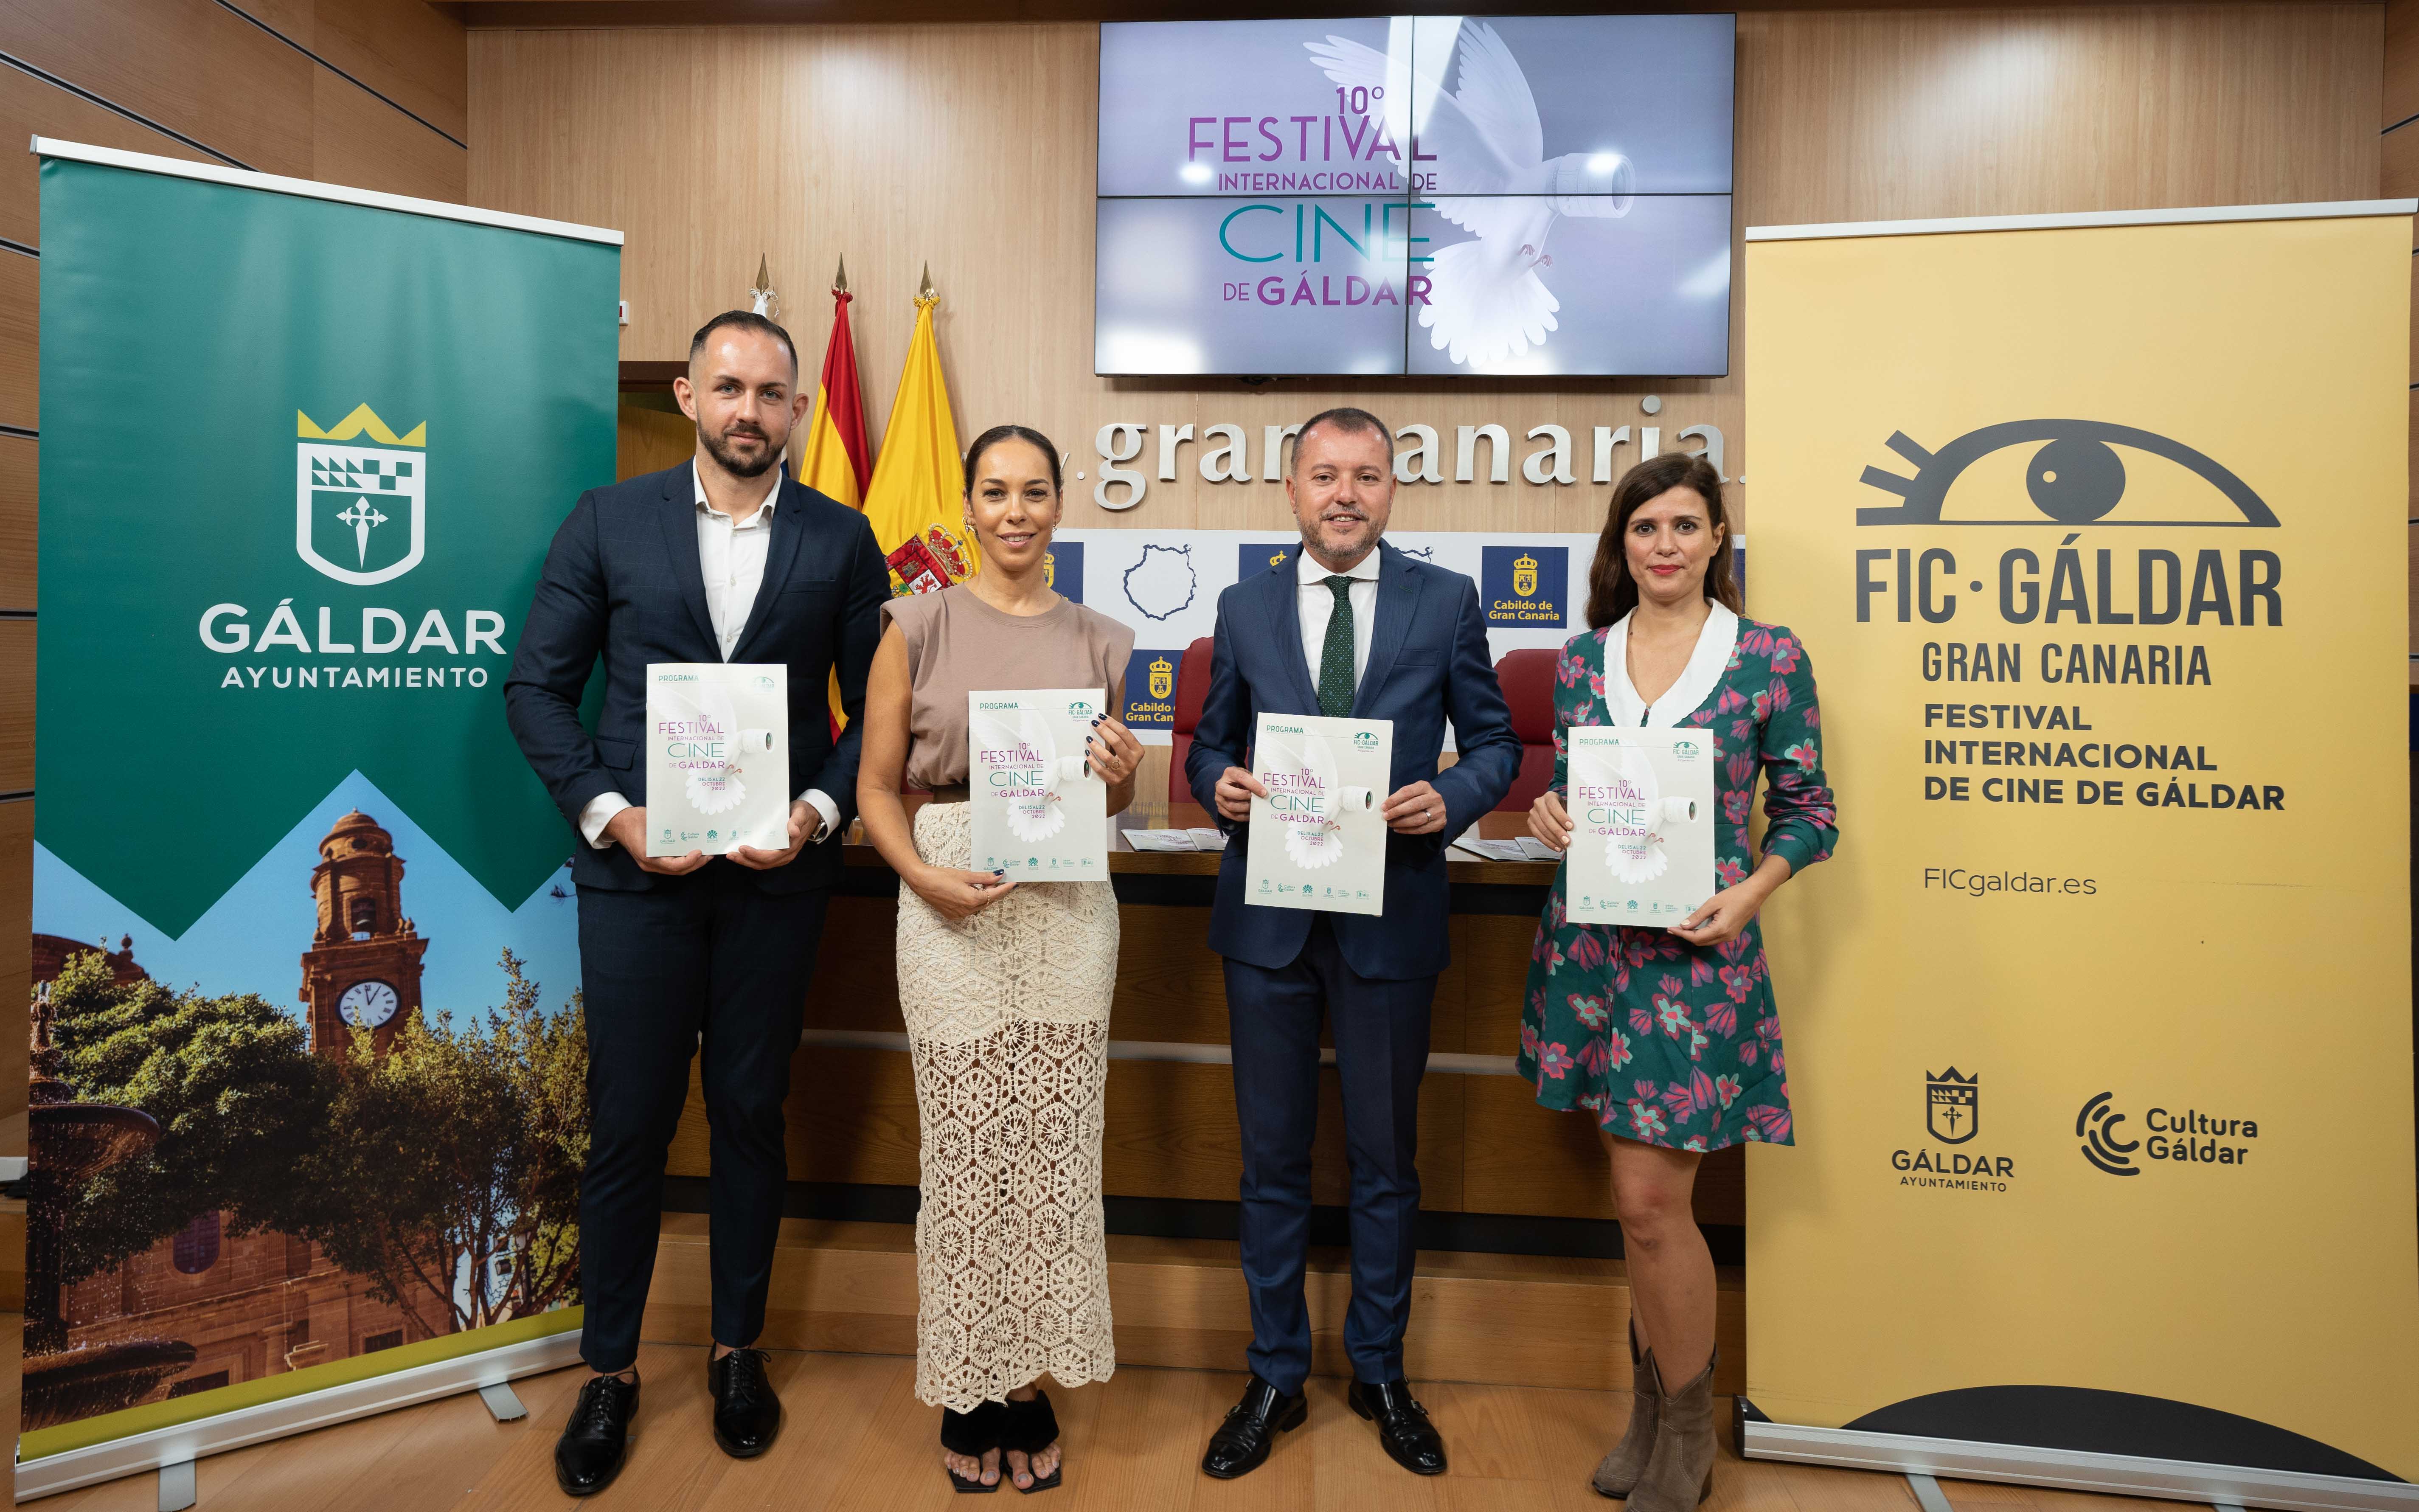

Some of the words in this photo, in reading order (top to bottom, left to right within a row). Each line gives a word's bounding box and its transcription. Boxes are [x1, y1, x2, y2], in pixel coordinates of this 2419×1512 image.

[1189, 115, 1437, 162] FESTIVAL
[1219, 172, 1399, 191] INTERNACIONAL
[1412, 173, 1437, 190] DE
[1219, 203, 1436, 262] CINE
[1224, 283, 1250, 301] DE
[1257, 270, 1432, 306] GÁLDAR
[1494, 600, 1536, 610] Cabildo
[1539, 601, 1553, 610] de
[1489, 610, 1515, 619] Gran
[1518, 611, 1559, 620] Canaria
[199, 598, 507, 654] GÁLDAR
[1922, 642, 2021, 682] GRAN
[2041, 644, 2211, 686] CANARIA
[221, 666, 488, 688] AYUNTAMIENTO
[1131, 703, 1171, 712] Cabildo
[1126, 712, 1151, 721] Gran
[1154, 713, 1174, 722] Can
[1925, 704, 2092, 730] FESTIVAL
[659, 722, 725, 734] FESTIVAL
[1267, 725, 1304, 734] PROGRAMA
[668, 743, 725, 758] CINE
[981, 750, 1043, 763] FESTIVAL
[1925, 740, 2217, 771] INTERNACIONAL
[989, 771, 1044, 786] CINE
[1264, 773, 1325, 788] FESTIVAL
[1579, 787, 1645, 800] FESTIVAL
[1925, 776, 1969, 801] DE
[1982, 777, 2064, 804] CINE
[2077, 780, 2124, 806] DE
[2135, 776, 2286, 811] GÁLDAR
[1271, 795, 1324, 812] CINE
[1588, 809, 1646, 825] CINE
[1924, 867, 2098, 897] FICgaldar.es
[2146, 1108, 2259, 1138] Cultura
[2147, 1135, 2248, 1165] Gáldar
[1891, 1149, 2014, 1178] GÁLDAR
[1900, 1176, 2007, 1192] AYUNTAMIENTO
